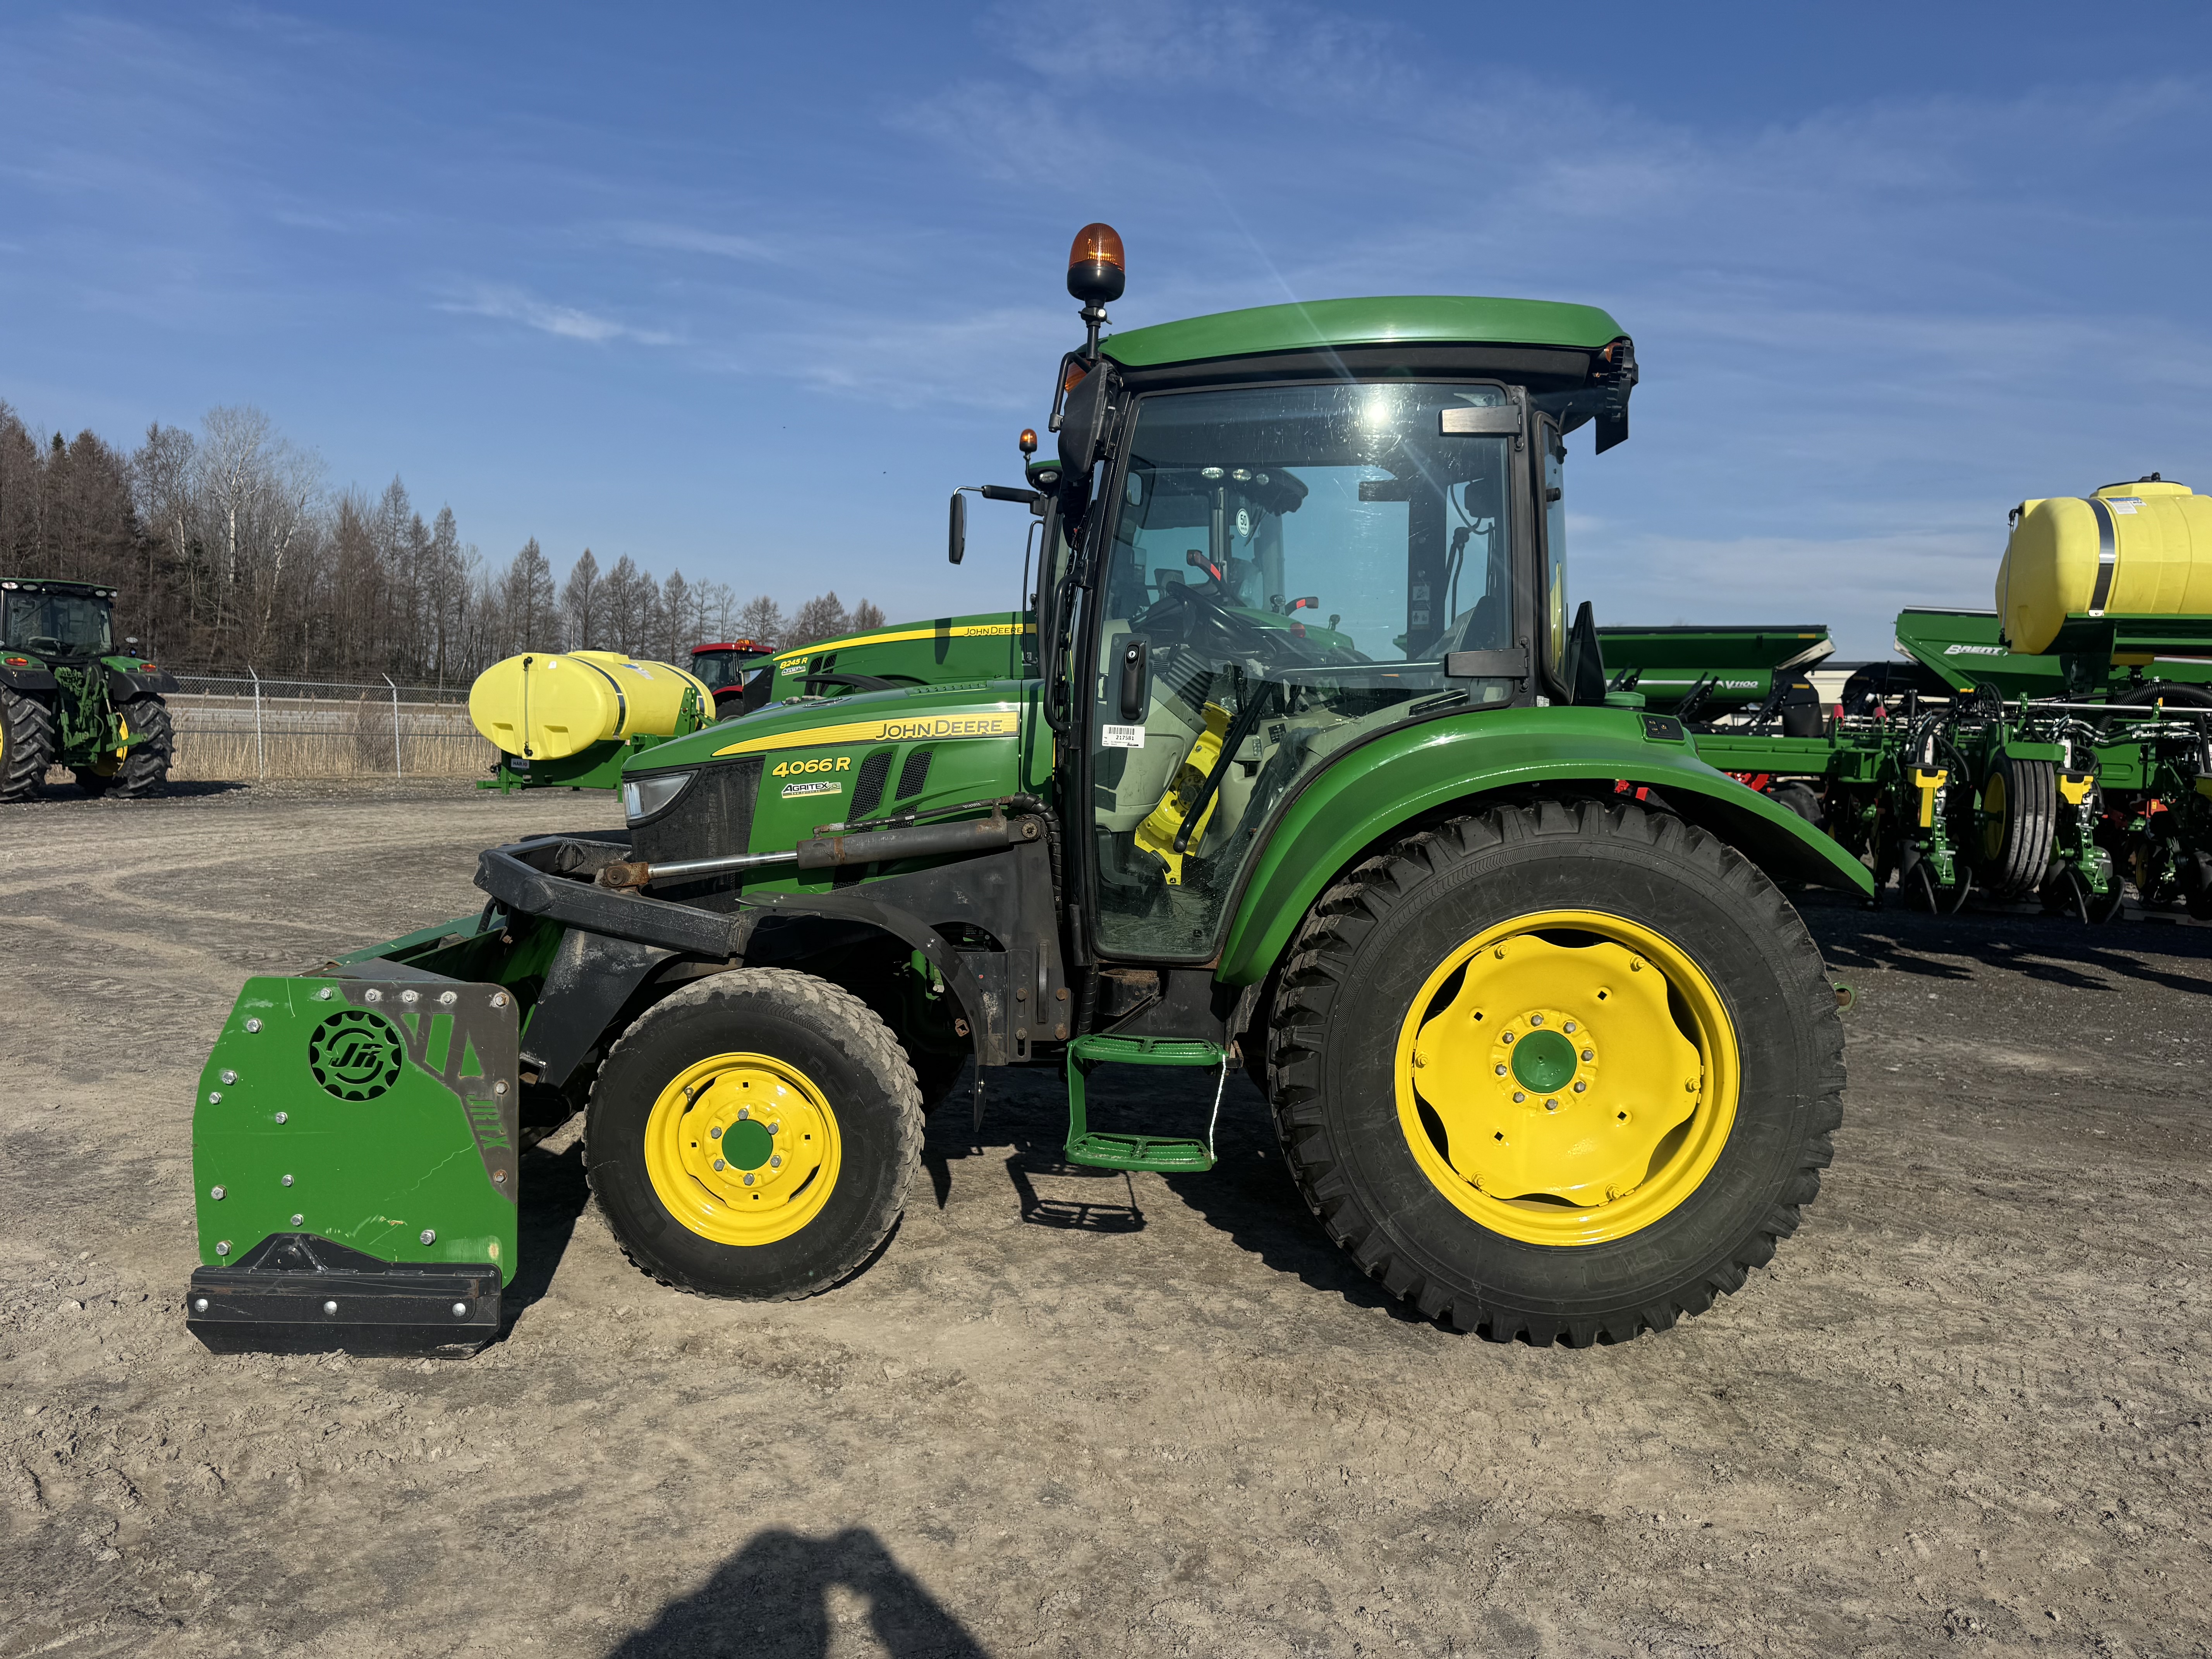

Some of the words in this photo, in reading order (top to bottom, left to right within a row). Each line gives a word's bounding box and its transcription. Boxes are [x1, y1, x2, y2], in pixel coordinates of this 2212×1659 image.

[1240, 514, 1247, 526] 50
[964, 627, 989, 635] JOHN
[1943, 644, 2003, 656] BRENT
[780, 658, 800, 669] 8245
[876, 723, 931, 739] JOHN
[935, 720, 1003, 734] DEERE
[772, 758, 833, 778] 4066
[835, 756, 851, 771] R
[783, 783, 828, 792] AGRITEX
[1614, 848, 1688, 879] ROTATION
